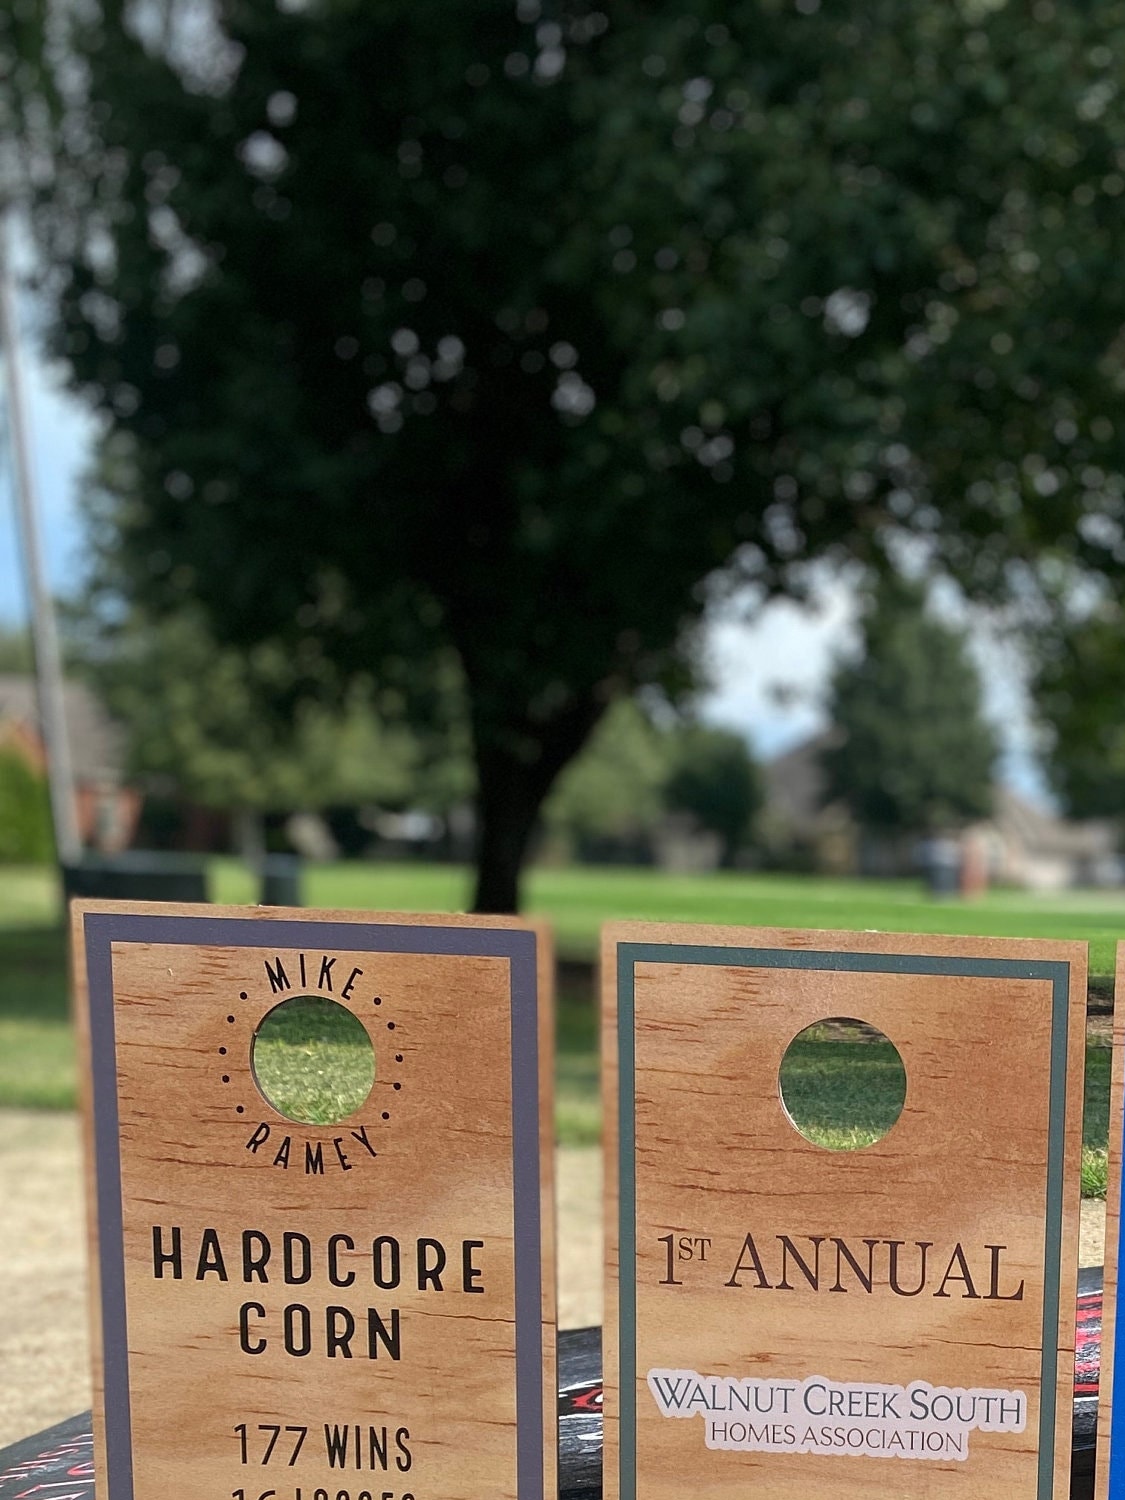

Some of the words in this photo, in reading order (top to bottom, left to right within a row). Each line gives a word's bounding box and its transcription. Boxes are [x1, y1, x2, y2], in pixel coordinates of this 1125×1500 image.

[264, 953, 364, 1000] MIKE
[246, 1122, 378, 1175] RAMEY
[152, 1226, 485, 1294] HARDCORE
[724, 1232, 1025, 1301] ANNUAL
[239, 1302, 401, 1360] CORN
[653, 1376, 795, 1414] WALNUT
[803, 1383, 902, 1419] CREEK
[909, 1388, 1022, 1425] SOUTH
[233, 1423, 308, 1466] 177
[324, 1423, 412, 1472] WINS
[711, 1422, 795, 1446] HOMES
[802, 1426, 963, 1452] ASSOCIATION
